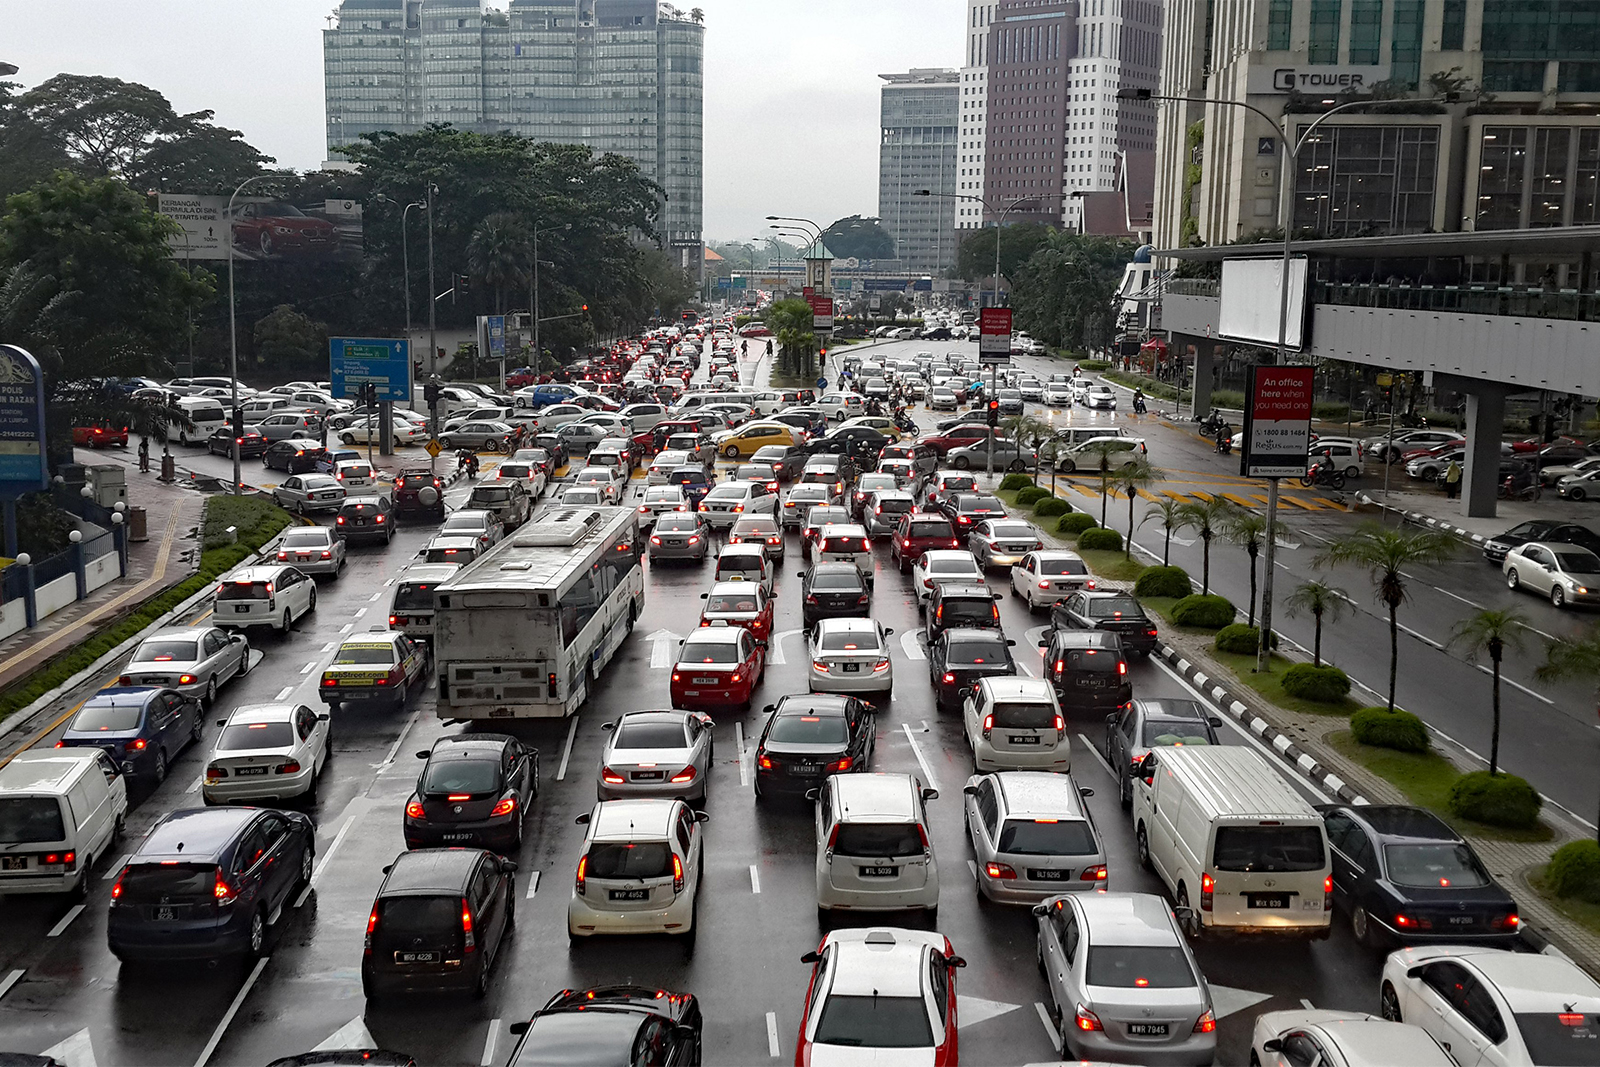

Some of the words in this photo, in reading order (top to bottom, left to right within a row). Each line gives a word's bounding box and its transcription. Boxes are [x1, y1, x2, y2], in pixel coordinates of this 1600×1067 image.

[1299, 73, 1364, 86] TOWER
[161, 206, 195, 214] BERMULA
[174, 213, 199, 221] STARTS
[1263, 377, 1276, 387] An
[1278, 378, 1304, 387] office
[1, 386, 23, 394] POLIS
[1261, 389, 1281, 398] here
[1282, 390, 1305, 398] when
[9, 396, 35, 404] RAZAK
[1255, 402, 1270, 411] you
[1271, 401, 1292, 409] need
[1131, 1025, 1146, 1034] WWR
[1147, 1025, 1166, 1034] 7945
